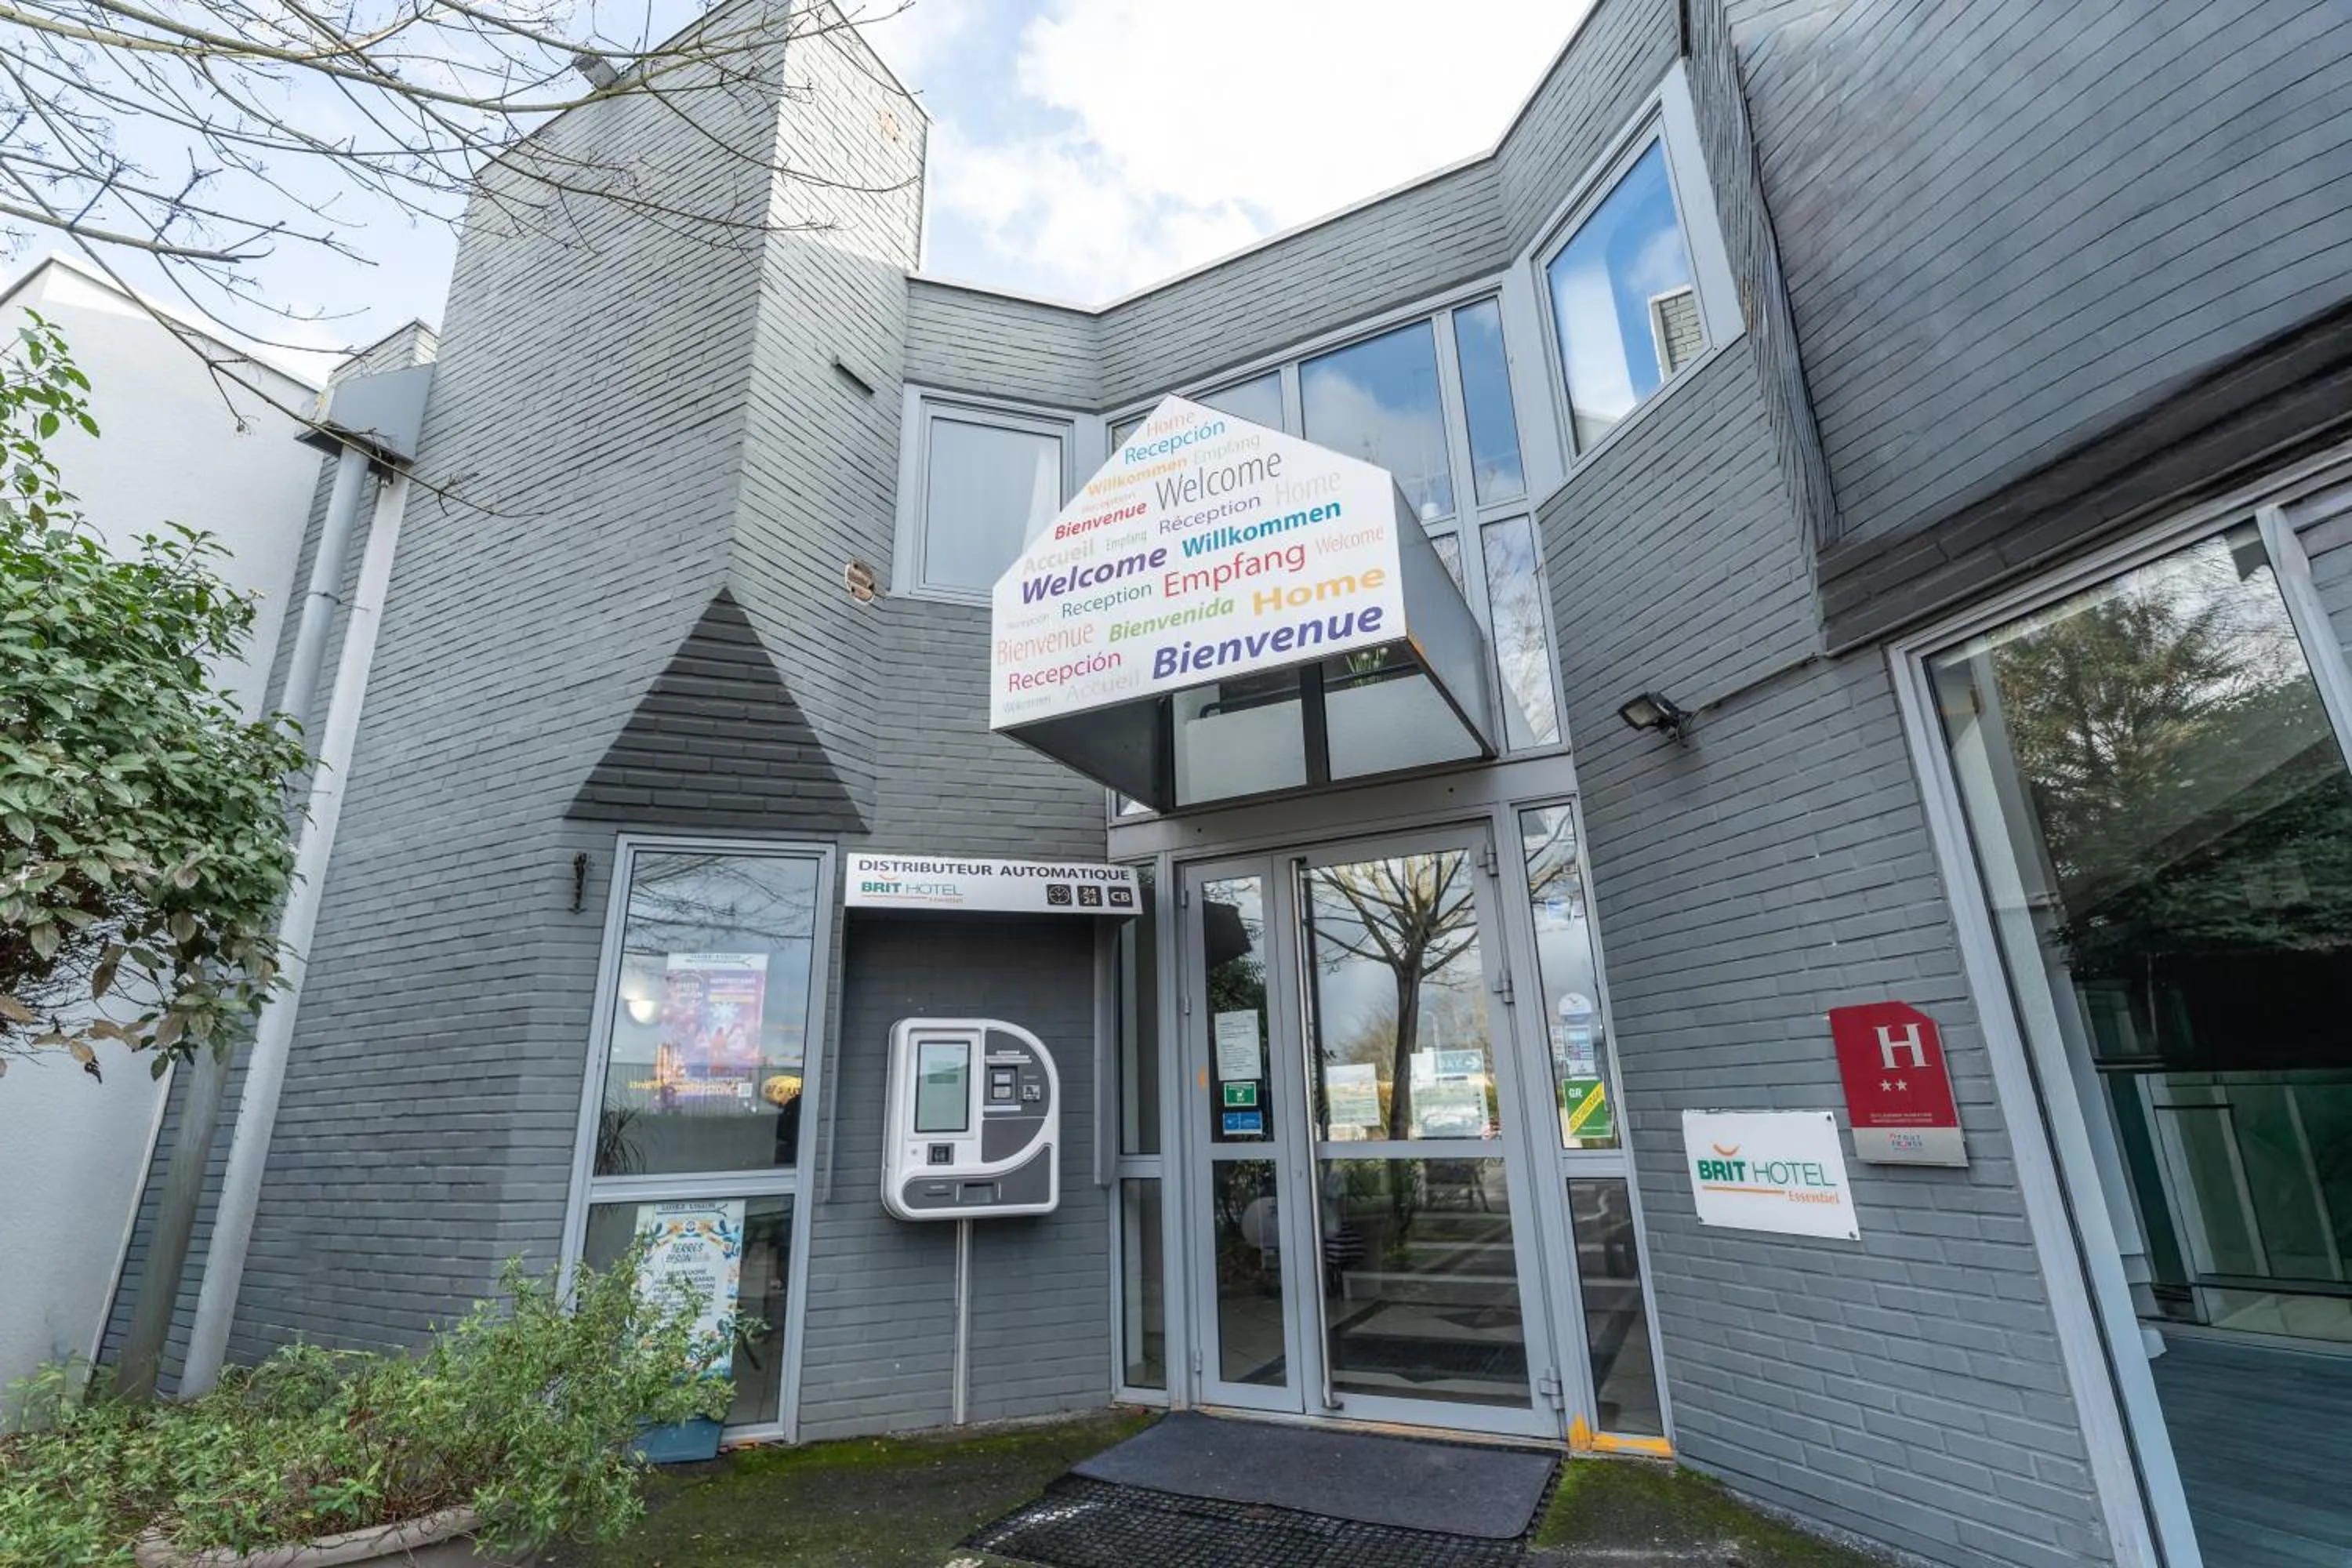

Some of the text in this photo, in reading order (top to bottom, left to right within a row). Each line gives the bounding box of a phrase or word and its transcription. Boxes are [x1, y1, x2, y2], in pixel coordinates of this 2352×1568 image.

[1125, 419, 1225, 464] Recepción
[1147, 410, 1195, 437] Home
[1194, 434, 1261, 465] Empfang
[1088, 456, 1187, 495] Willkommen
[1156, 452, 1281, 510] Welcome
[1275, 471, 1341, 506] Home
[1054, 500, 1147, 540] Bienvenue
[1159, 495, 1261, 535] Réception
[1182, 499, 1341, 558] Willkommen
[1023, 537, 1094, 574] Accueil
[1316, 525, 1385, 555] Welcome
[1022, 547, 1167, 604] Welcome
[1163, 543, 1306, 597] Empfang
[1062, 581, 1152, 618] Reception
[1253, 568, 1385, 616] Home
[1109, 597, 1234, 643] Bienvenida
[997, 621, 1094, 666] Bienvenue
[1152, 605, 1384, 680] Bienvenue
[1008, 648, 1121, 693] Recepción
[1065, 671, 1140, 702] Accueil
[858, 859, 1130, 880] DISTRIBUTEUR AUTOMATIQUE
[861, 881, 964, 897] BRIT HOTEL
[1082, 887, 1097, 895] 24
[1110, 891, 1130, 903] CB
[1873, 1022, 1932, 1069] H
[1697, 1160, 1837, 1187] BRIT HOTEL
[1788, 1189, 1840, 1205] Essentiel
